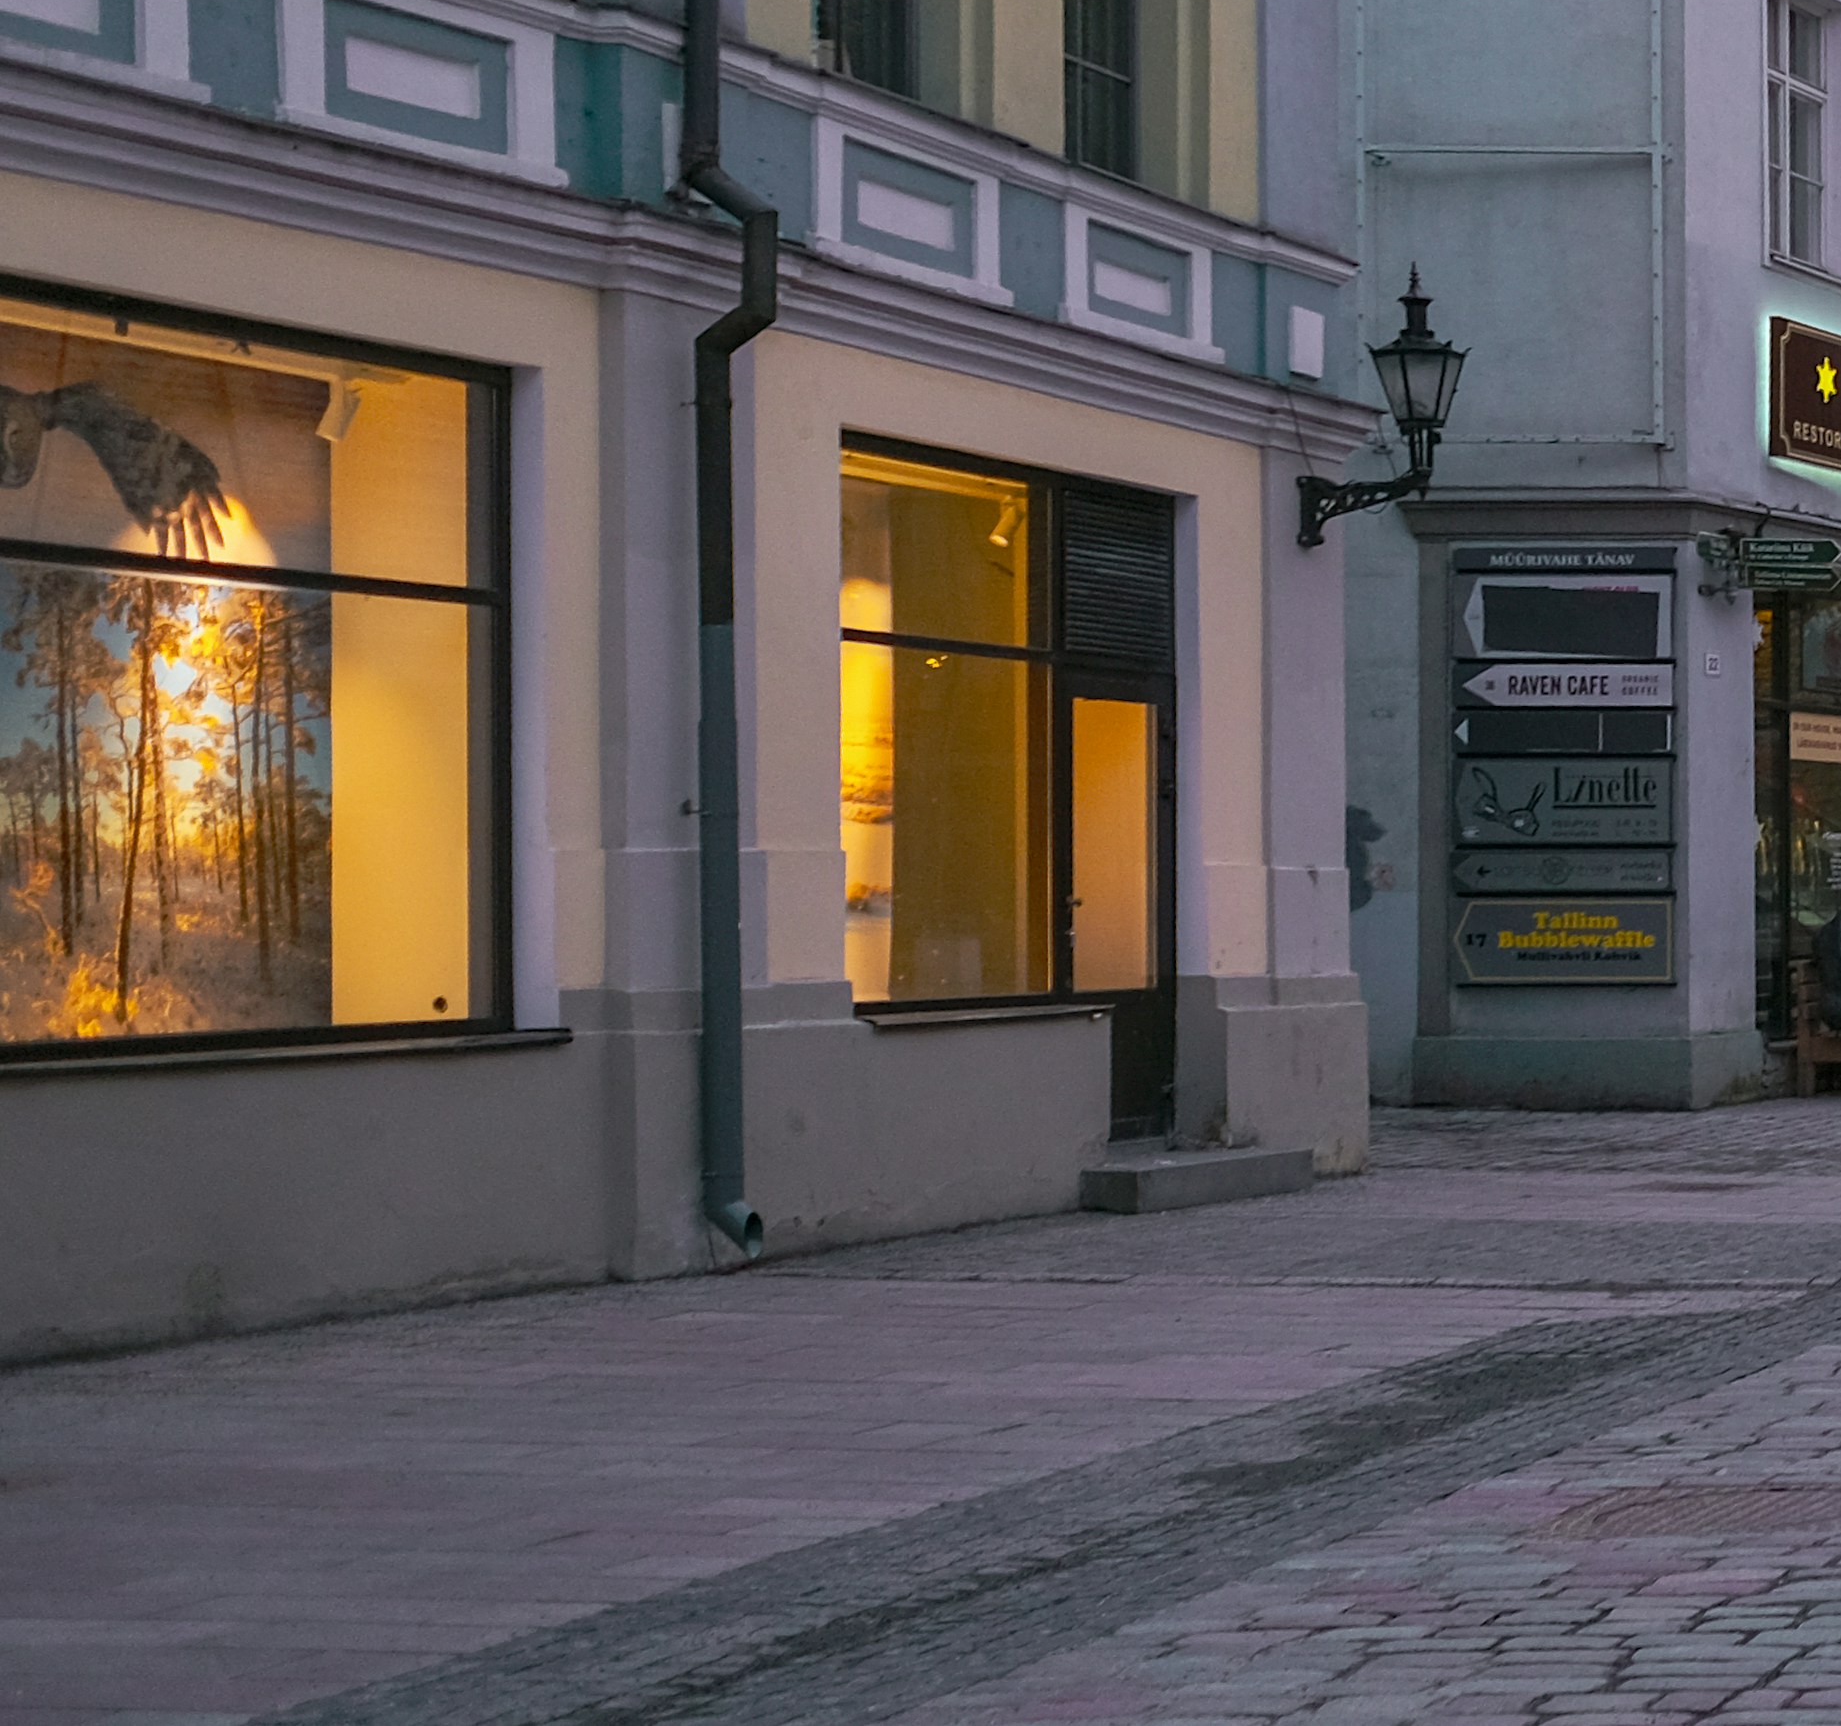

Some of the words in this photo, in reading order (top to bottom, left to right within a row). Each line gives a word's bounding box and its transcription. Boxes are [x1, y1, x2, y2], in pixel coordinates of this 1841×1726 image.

[1489, 552, 1582, 566] MÜÜRIVAHE
[1586, 553, 1635, 566] TÄNAV
[1508, 675, 1561, 695] RAVEN
[1567, 675, 1610, 695] CAFE
[1553, 767, 1657, 803] Linette
[1532, 911, 1620, 929] Tallinn
[1465, 933, 1487, 947] 17
[1497, 930, 1656, 948] Bubblewaffle
